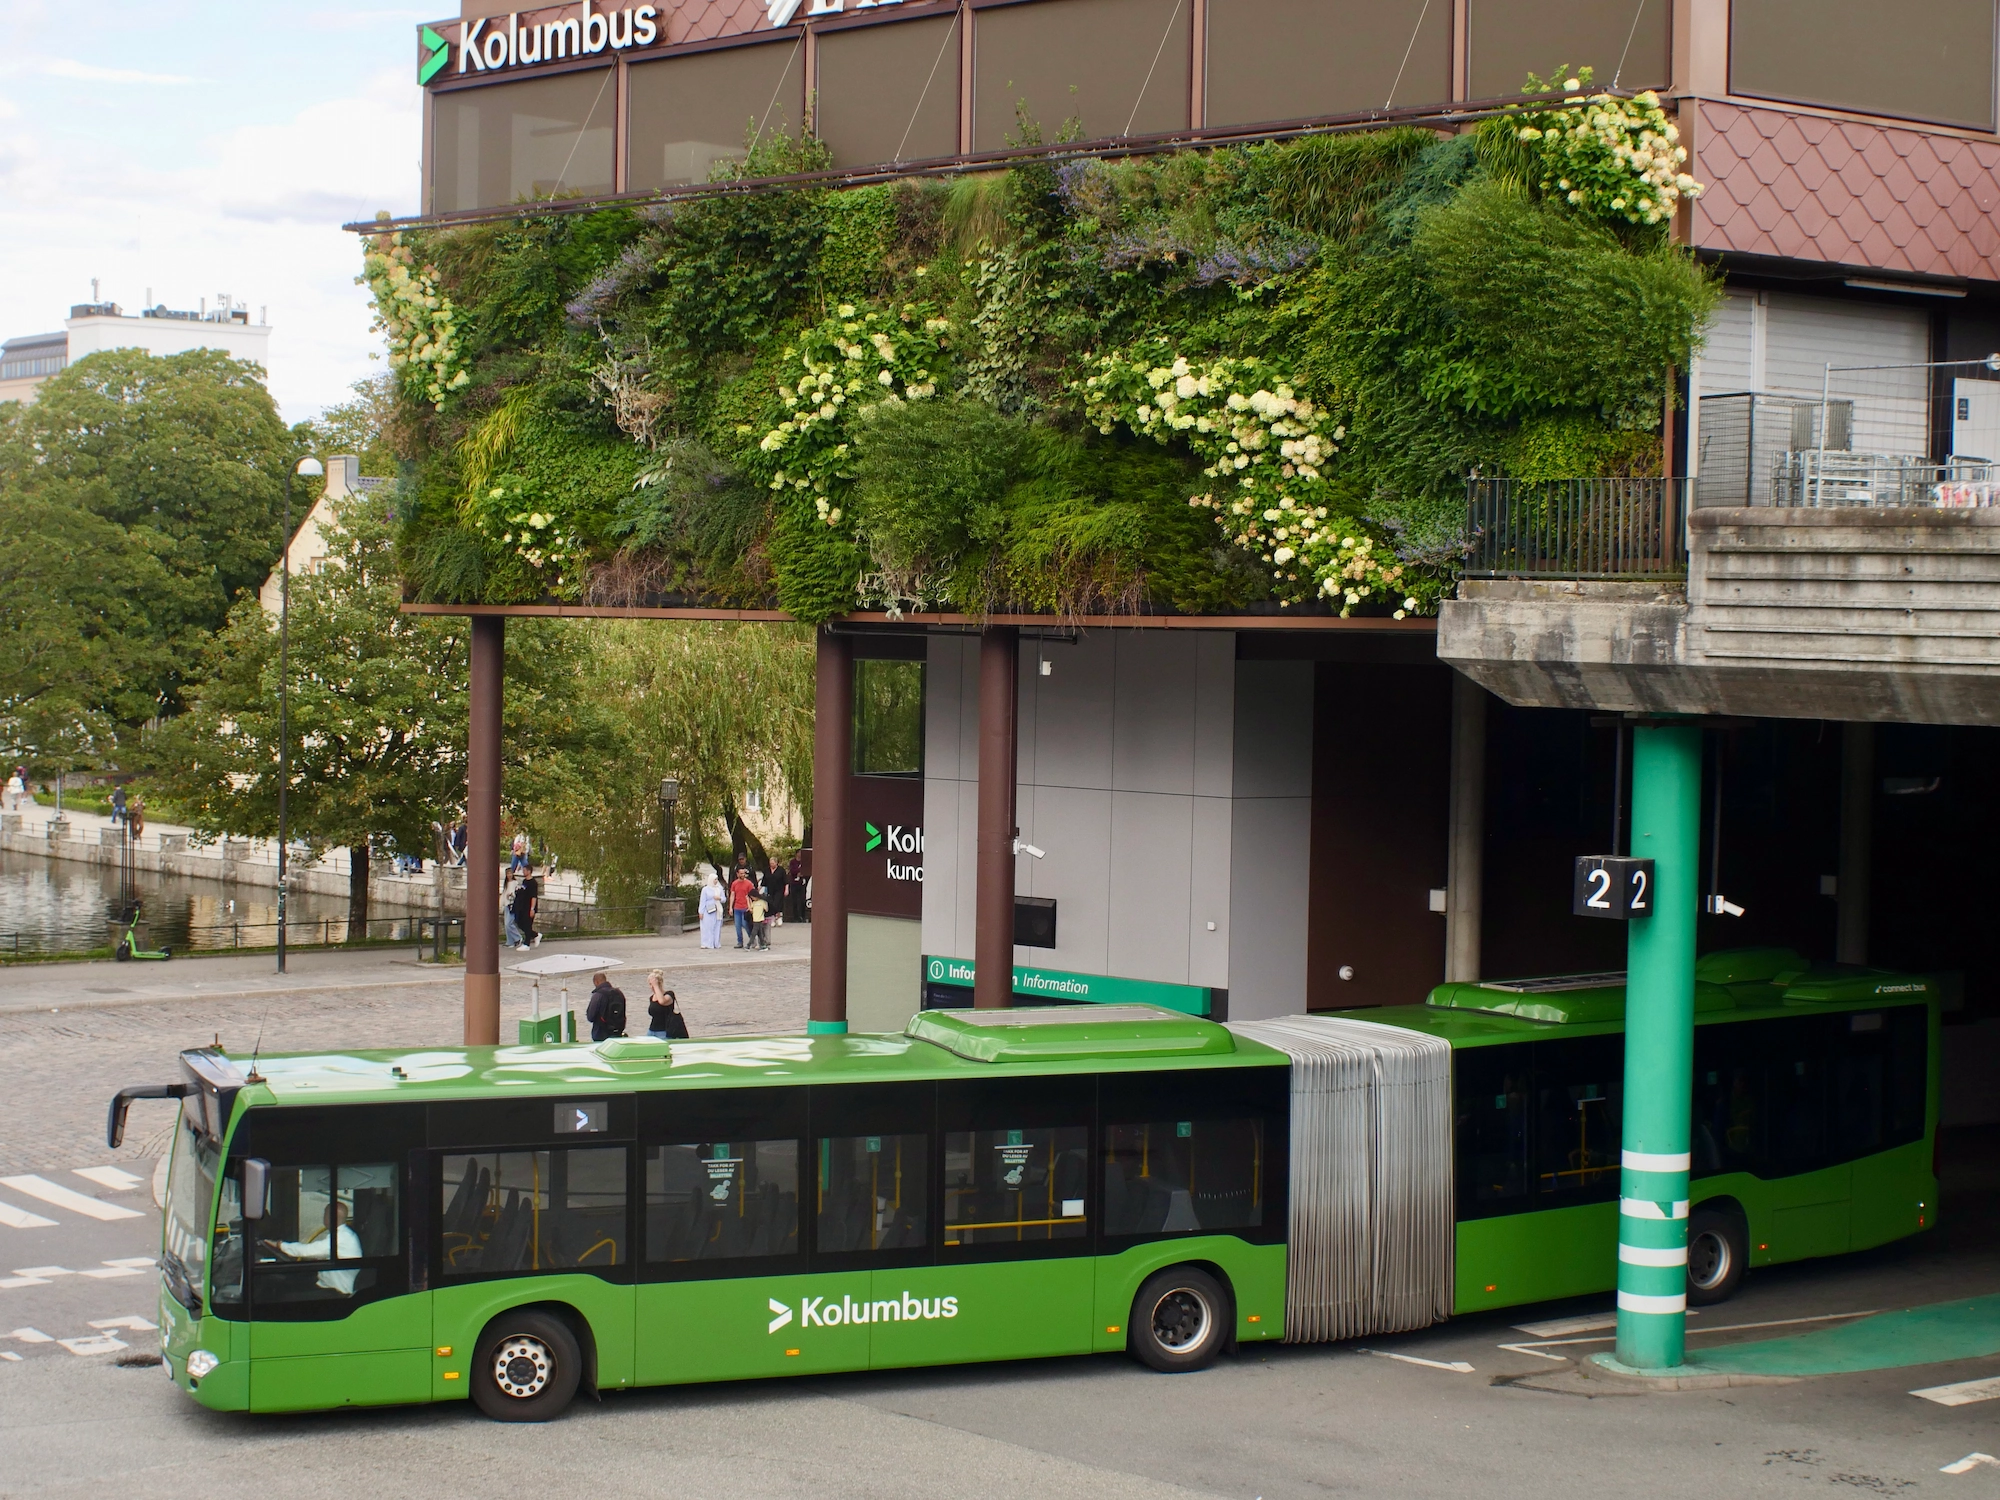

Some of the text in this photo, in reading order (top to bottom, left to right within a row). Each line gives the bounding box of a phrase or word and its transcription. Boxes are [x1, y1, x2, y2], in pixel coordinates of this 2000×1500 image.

[459, 0, 657, 73] Kolumbus
[1587, 868, 1611, 909] 2
[1631, 870, 1647, 909] 2
[1023, 973, 1089, 995] Information
[1882, 984, 1912, 993] connect
[802, 1291, 958, 1327] Kolumbus
